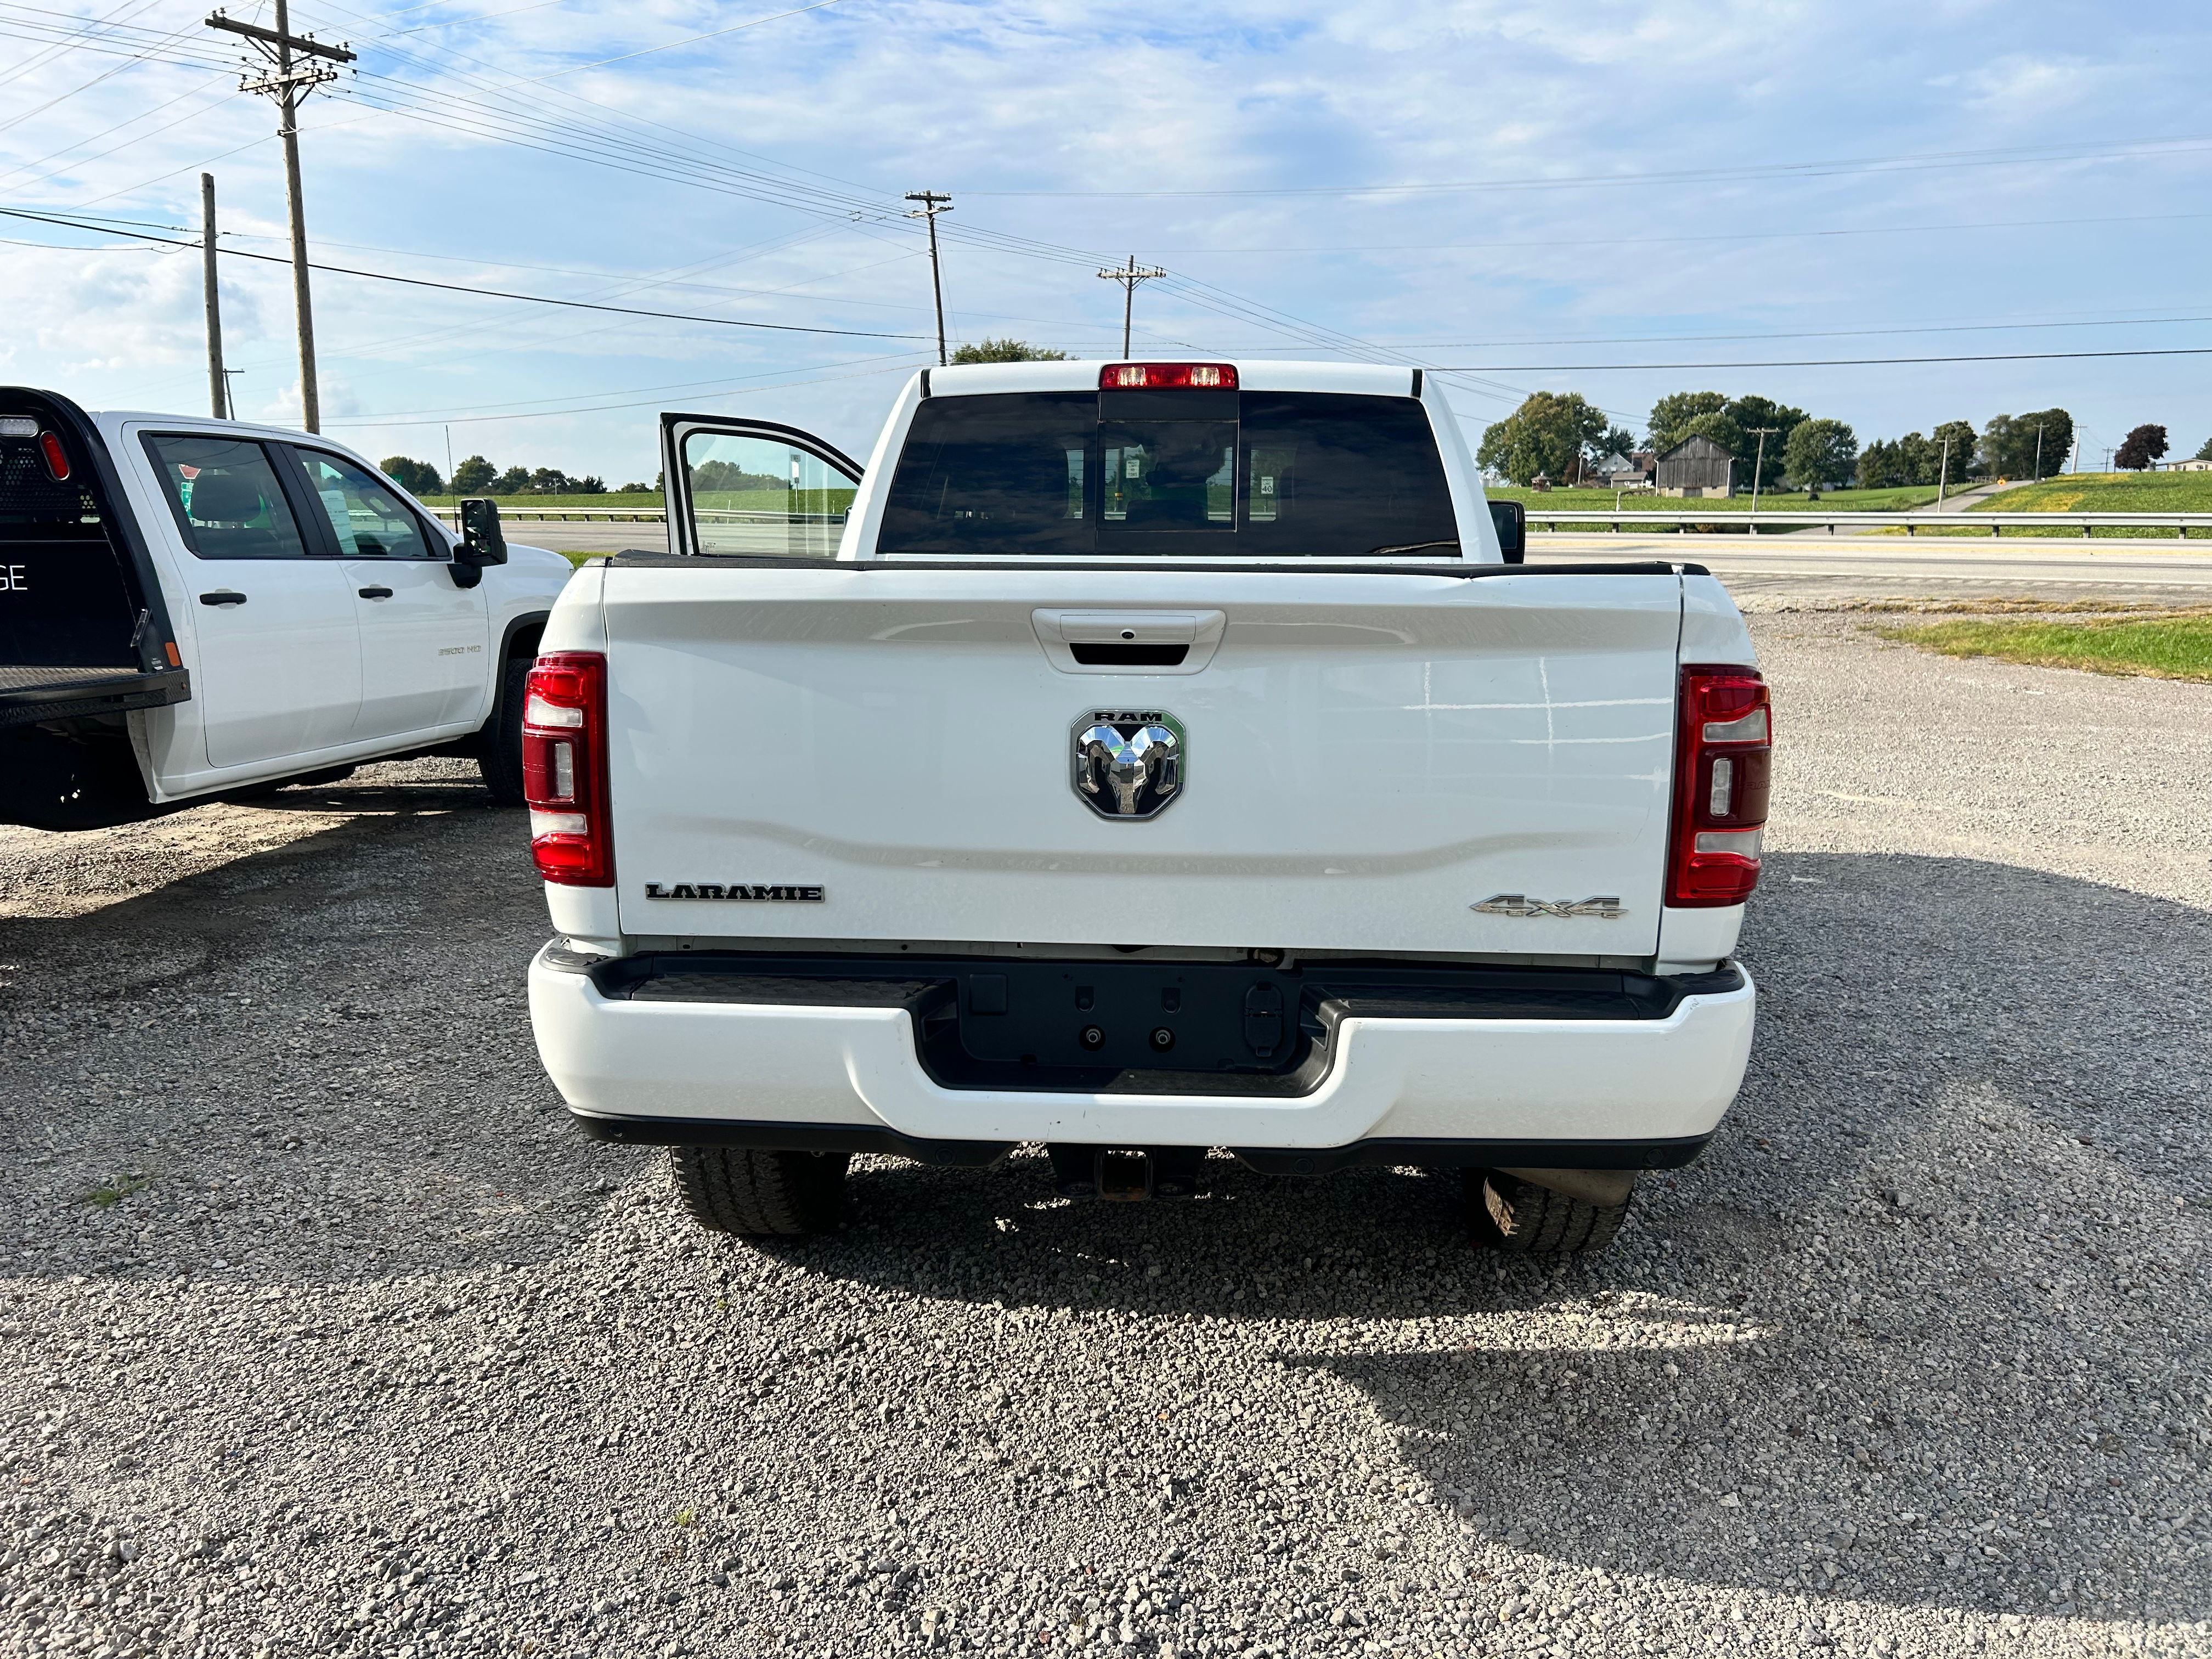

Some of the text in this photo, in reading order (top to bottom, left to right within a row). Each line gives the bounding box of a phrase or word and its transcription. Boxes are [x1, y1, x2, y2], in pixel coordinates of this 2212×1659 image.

[1094, 713, 1162, 721] RAM
[645, 882, 825, 902] LARAMIE
[1469, 894, 1629, 918] 4x4
